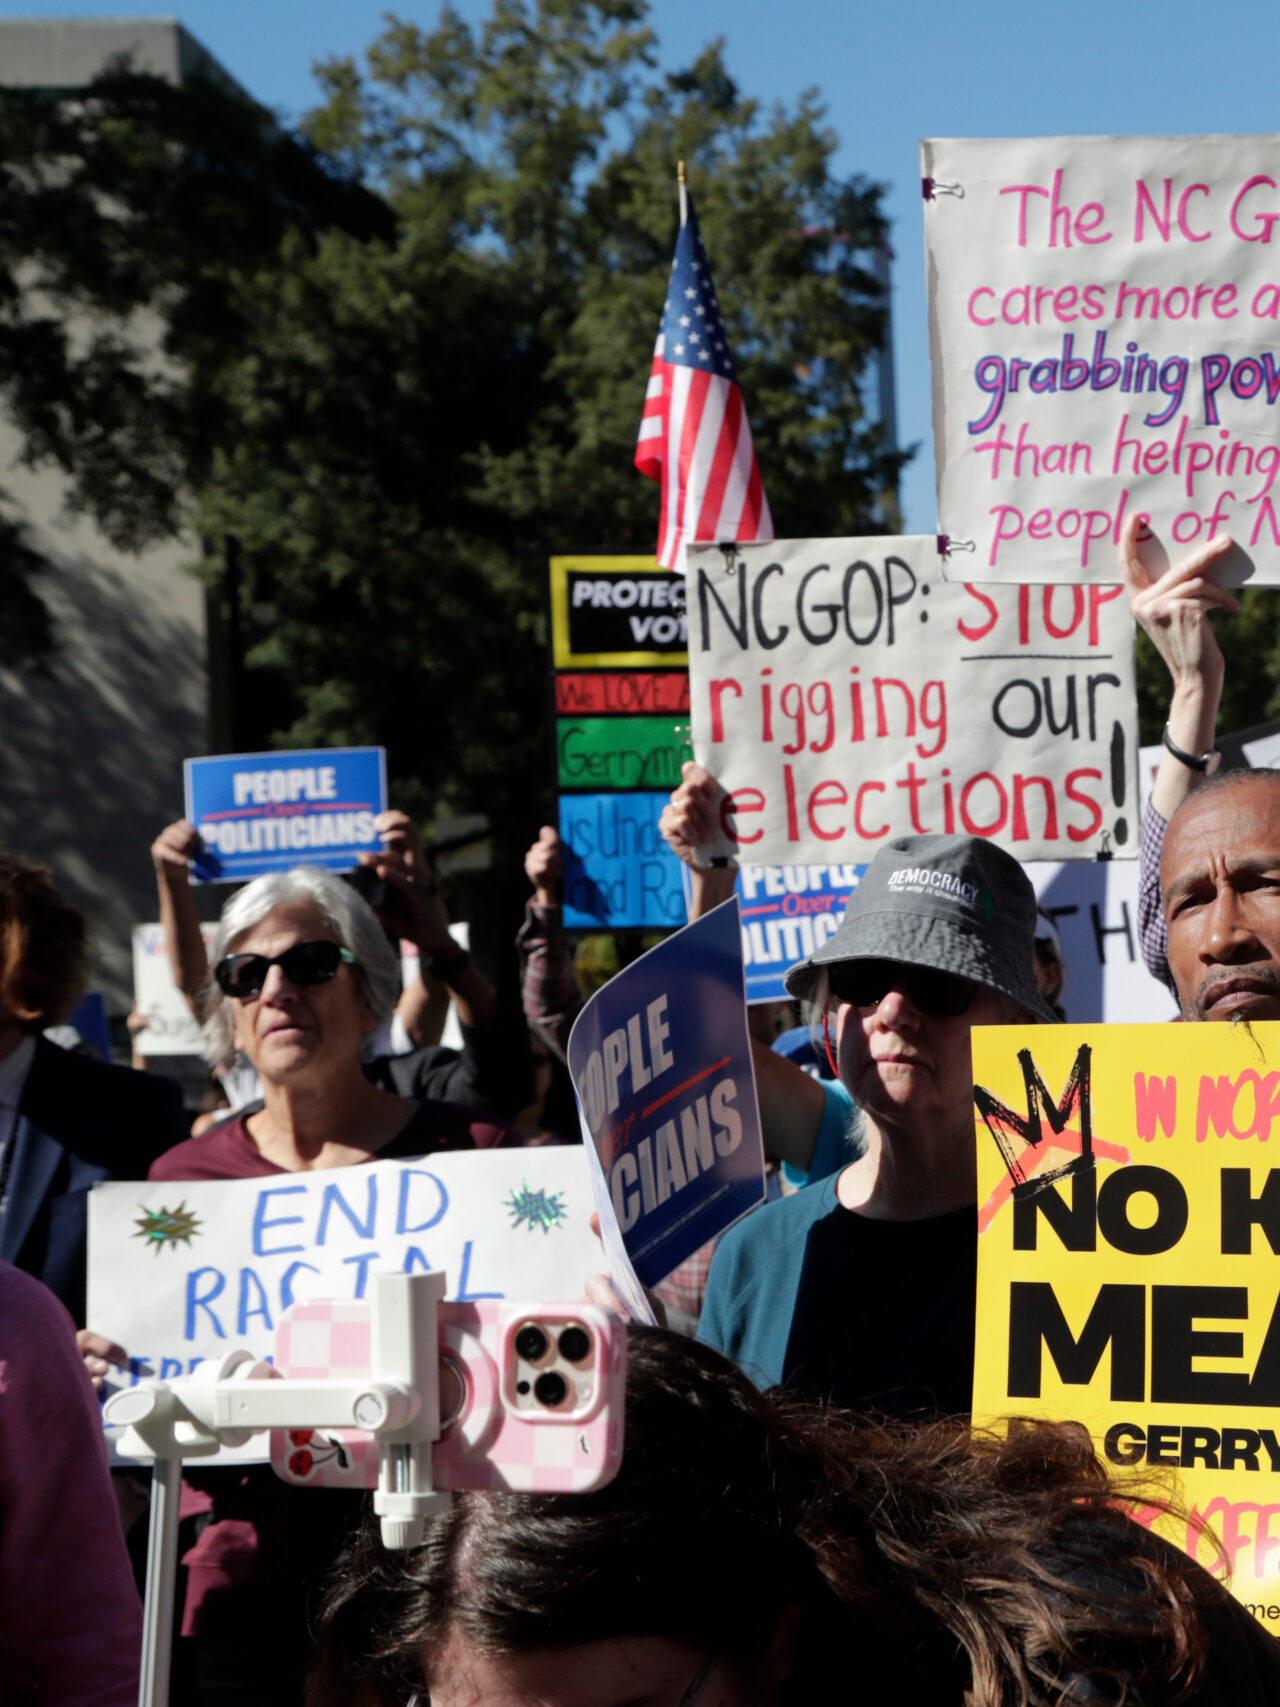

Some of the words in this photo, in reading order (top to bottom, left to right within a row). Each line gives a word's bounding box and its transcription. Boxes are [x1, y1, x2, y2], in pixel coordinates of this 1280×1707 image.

[1000, 168, 1112, 247] The
[1133, 178, 1212, 243] NC
[967, 284, 1105, 326] cares
[1115, 281, 1239, 320] more
[968, 330, 1189, 434] grabbing
[974, 421, 1092, 480] than
[1171, 491, 1236, 544] of
[571, 580, 687, 609] PROTEC
[628, 614, 688, 643] VOT
[602, 673, 668, 710] LOVE
[709, 667, 948, 759] rigging
[992, 673, 1121, 741] our
[233, 767, 337, 805] PEOPLE
[262, 802, 309, 818] Over
[721, 720, 1128, 847] elections!
[640, 861, 684, 921] Ra
[782, 894, 836, 916] Over
[888, 868, 978, 902] DEMOCRACY
[578, 993, 674, 1134] OPLE
[1134, 1071, 1176, 1142] IN
[607, 1078, 743, 1236] CIANS
[252, 1168, 449, 1257] END
[1012, 1164, 1189, 1256] NO
